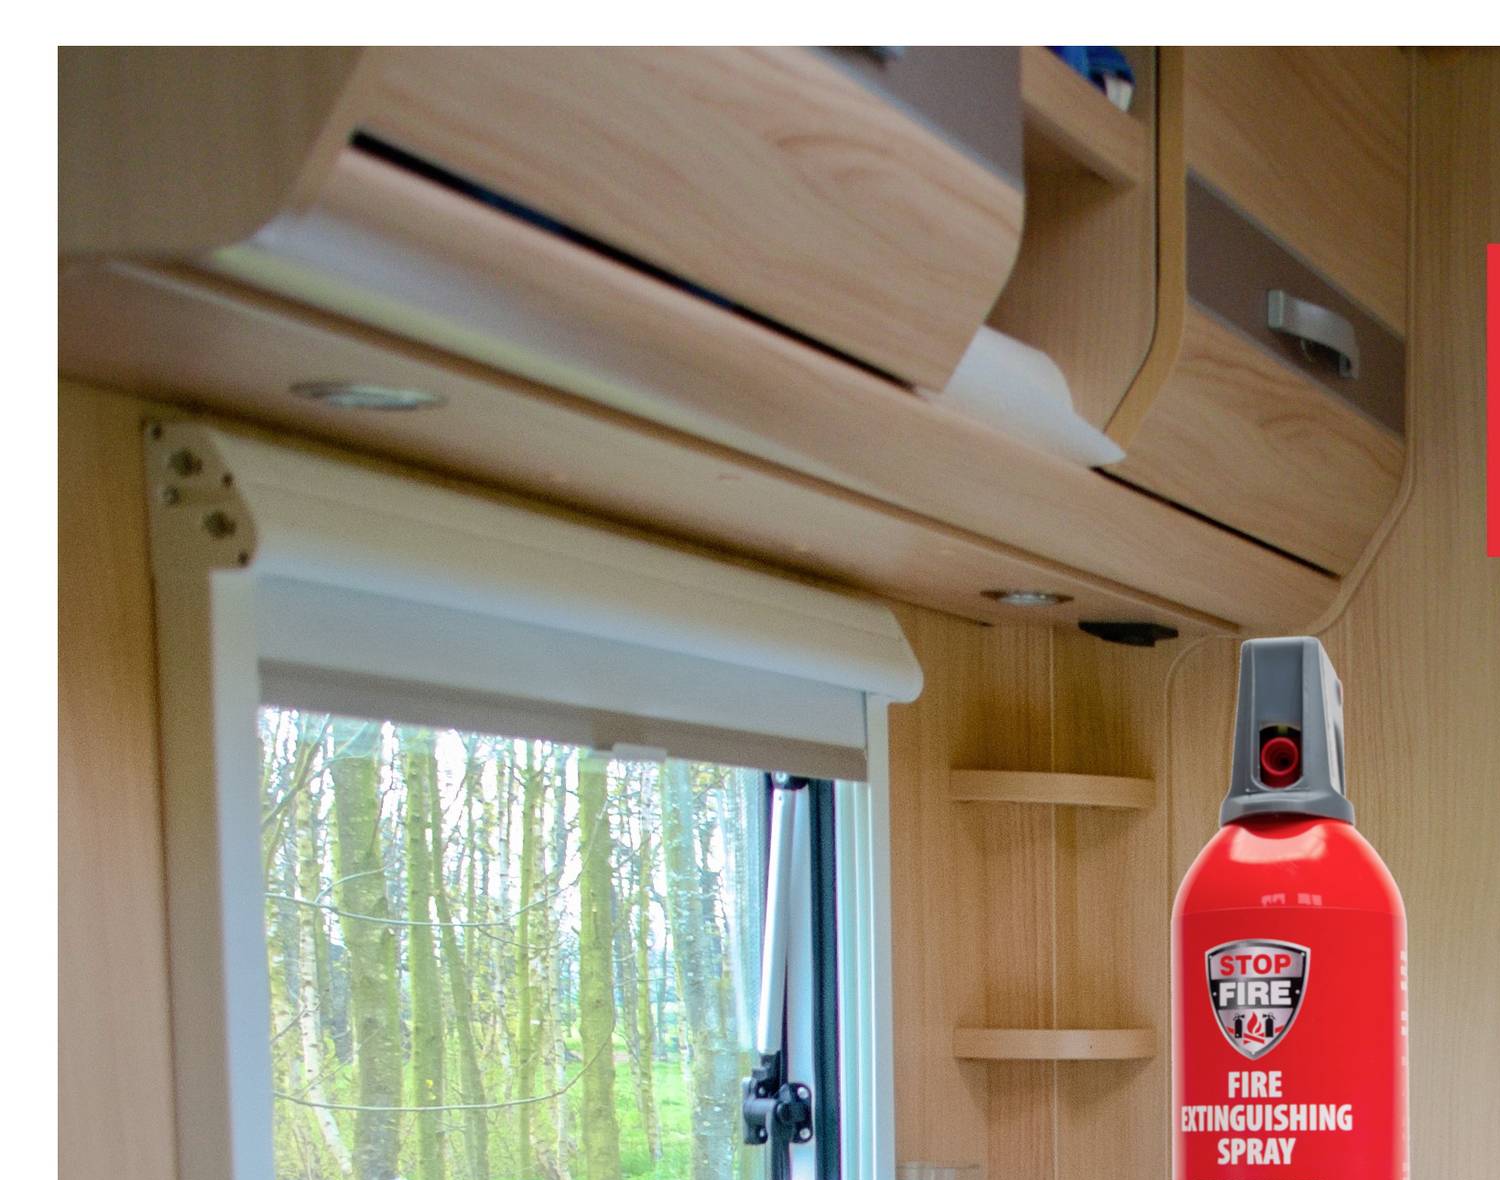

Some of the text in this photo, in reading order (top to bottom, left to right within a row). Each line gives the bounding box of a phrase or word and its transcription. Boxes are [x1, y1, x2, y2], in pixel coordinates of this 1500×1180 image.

[1220, 954, 1291, 976] STOP
[1219, 980, 1292, 1006] FIRE
[1228, 1071, 1282, 1098] FIRE
[1181, 1104, 1353, 1132] EXTINGUISHING
[1217, 1138, 1296, 1165] SPRAY
